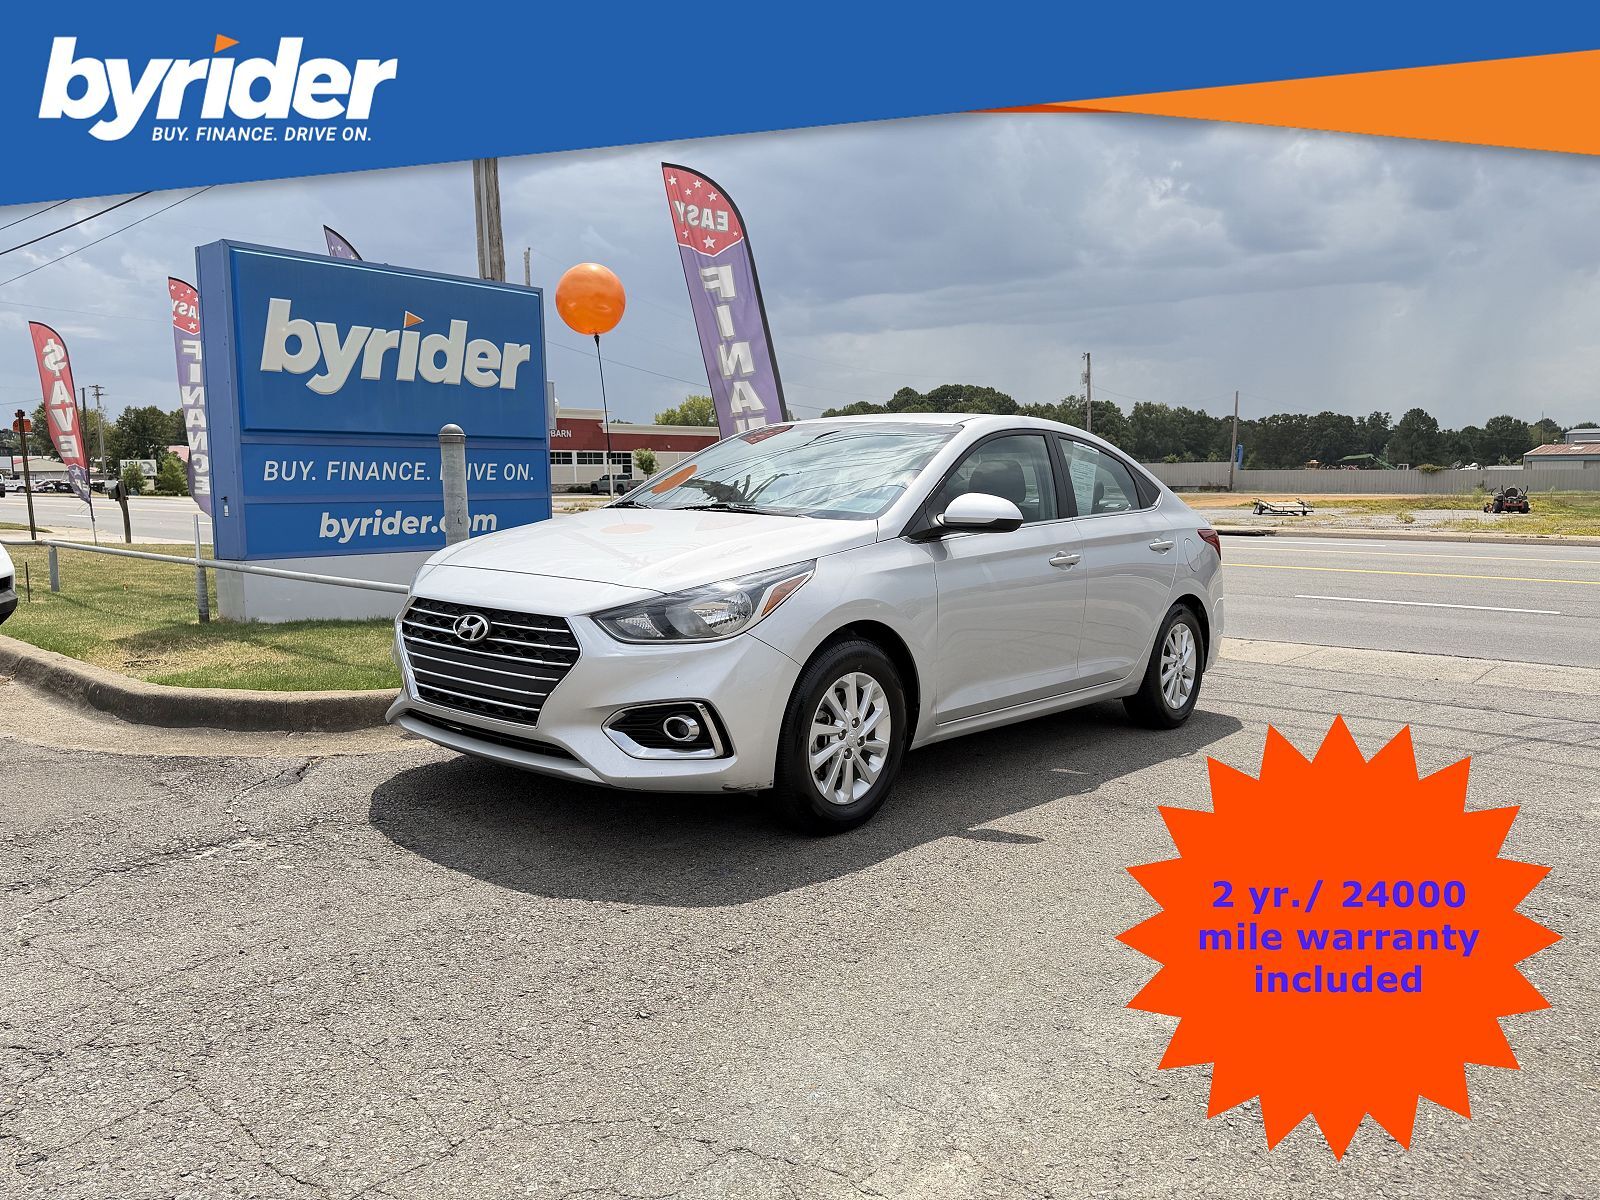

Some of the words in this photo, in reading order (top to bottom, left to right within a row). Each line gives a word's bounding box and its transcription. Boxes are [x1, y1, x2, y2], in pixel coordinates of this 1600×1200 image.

[260, 297, 531, 395] byrider
[550, 429, 572, 438] BARN
[263, 460, 317, 481] BUY.
[326, 461, 431, 481] FINANCE.
[440, 462, 498, 481] IVE
[503, 463, 534, 481] ON.
[319, 508, 498, 544] byrider.m
